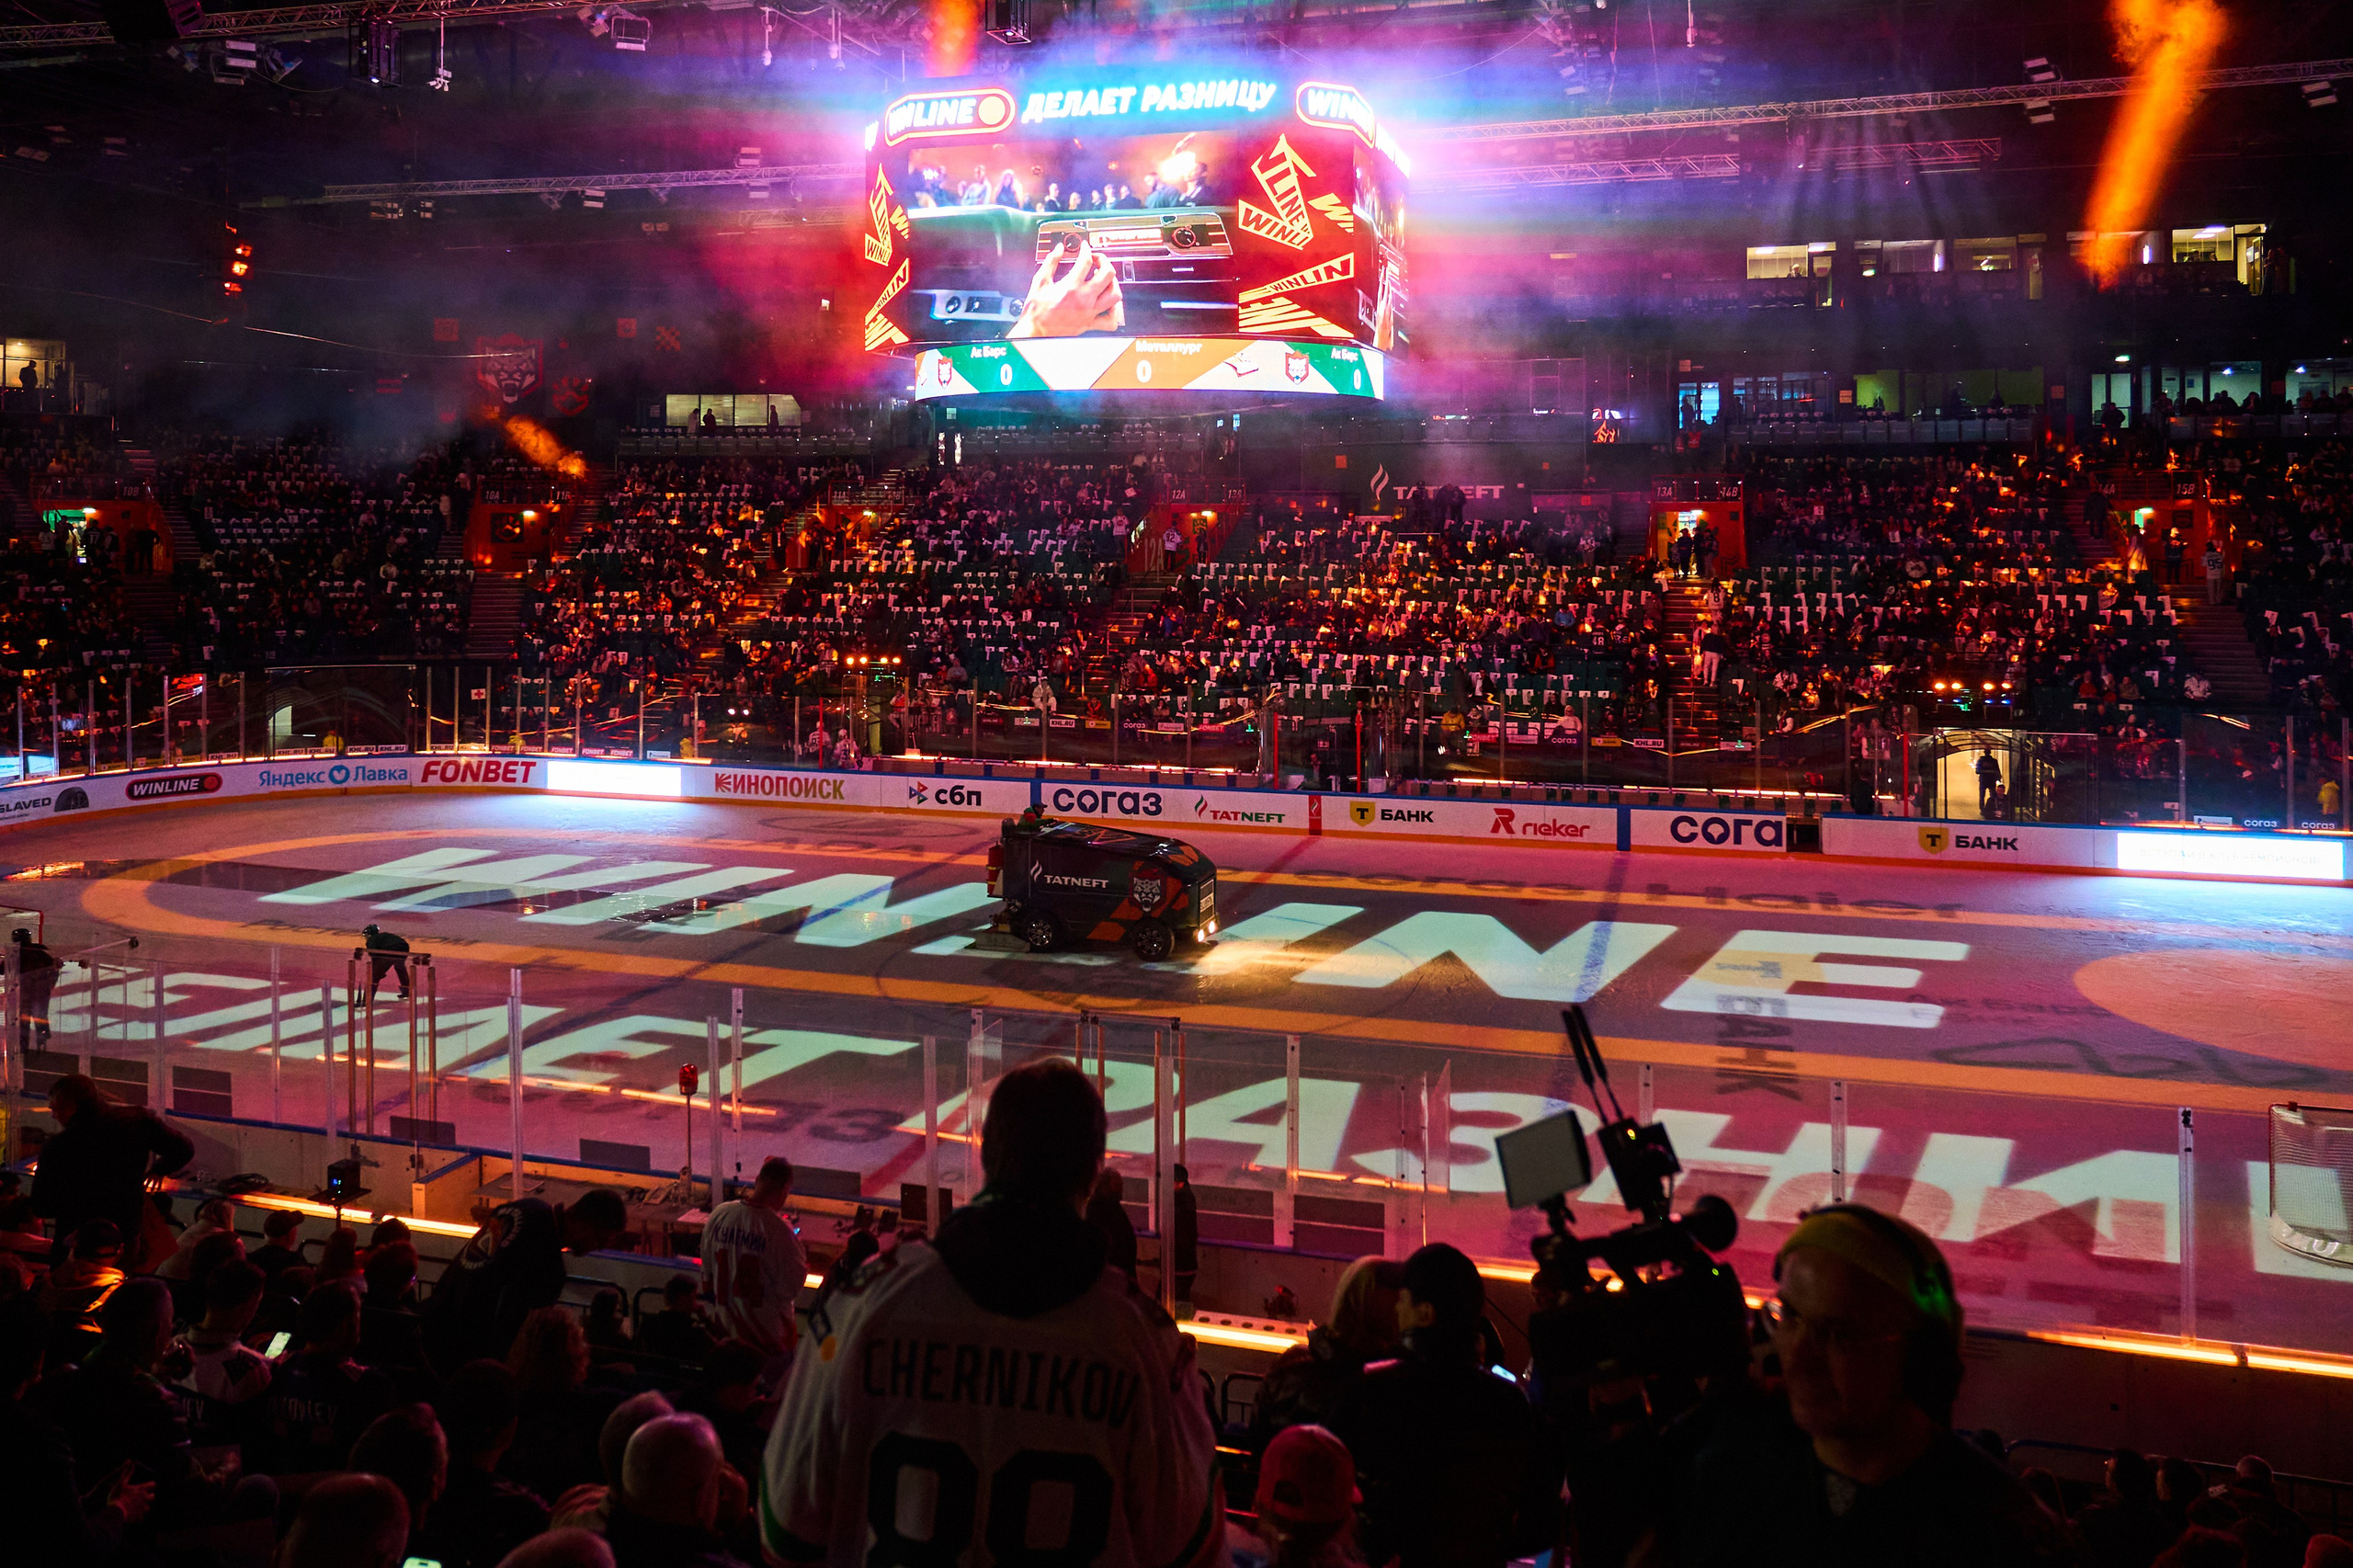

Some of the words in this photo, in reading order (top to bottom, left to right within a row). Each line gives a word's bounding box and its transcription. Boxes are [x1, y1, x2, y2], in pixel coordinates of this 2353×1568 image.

[1021, 86, 1137, 124] ДЕЛАЕТ
[1141, 78, 1277, 112] РАЗНИЦУ
[1135, 341, 1203, 356] Металлург
[1000, 363, 1012, 386] 0
[1136, 359, 1153, 383] 0
[1353, 368, 1361, 390] 0
[1172, 489, 1186, 499] 12A
[1392, 484, 1505, 500] TATEFT
[1656, 486, 1673, 497] 13A
[2177, 483, 2195, 494] 15B
[2208, 558, 2223, 570] 95
[1591, 636, 1605, 646] 48
[1551, 736, 1577, 744] согаз
[1635, 739, 1663, 747] KHL.RU
[258, 769, 325, 788] Яндекс
[353, 766, 408, 783] Лавка
[421, 760, 537, 784] FONBET
[132, 778, 200, 796] WINLINE
[714, 773, 845, 801] КИНОПОИСК
[935, 785, 982, 807] сбп
[1052, 787, 1164, 816] согаз
[1210, 810, 1286, 824] TATNEFT
[1381, 809, 1434, 824] БАНК
[2244, 818, 2278, 828] согаз
[1522, 821, 1590, 838] rieker
[2302, 820, 2336, 830] согаз
[1954, 834, 2018, 851] БАНК
[1043, 874, 1109, 890] TATNEFT
[862, 1337, 1142, 1429] CHERNIKOV
